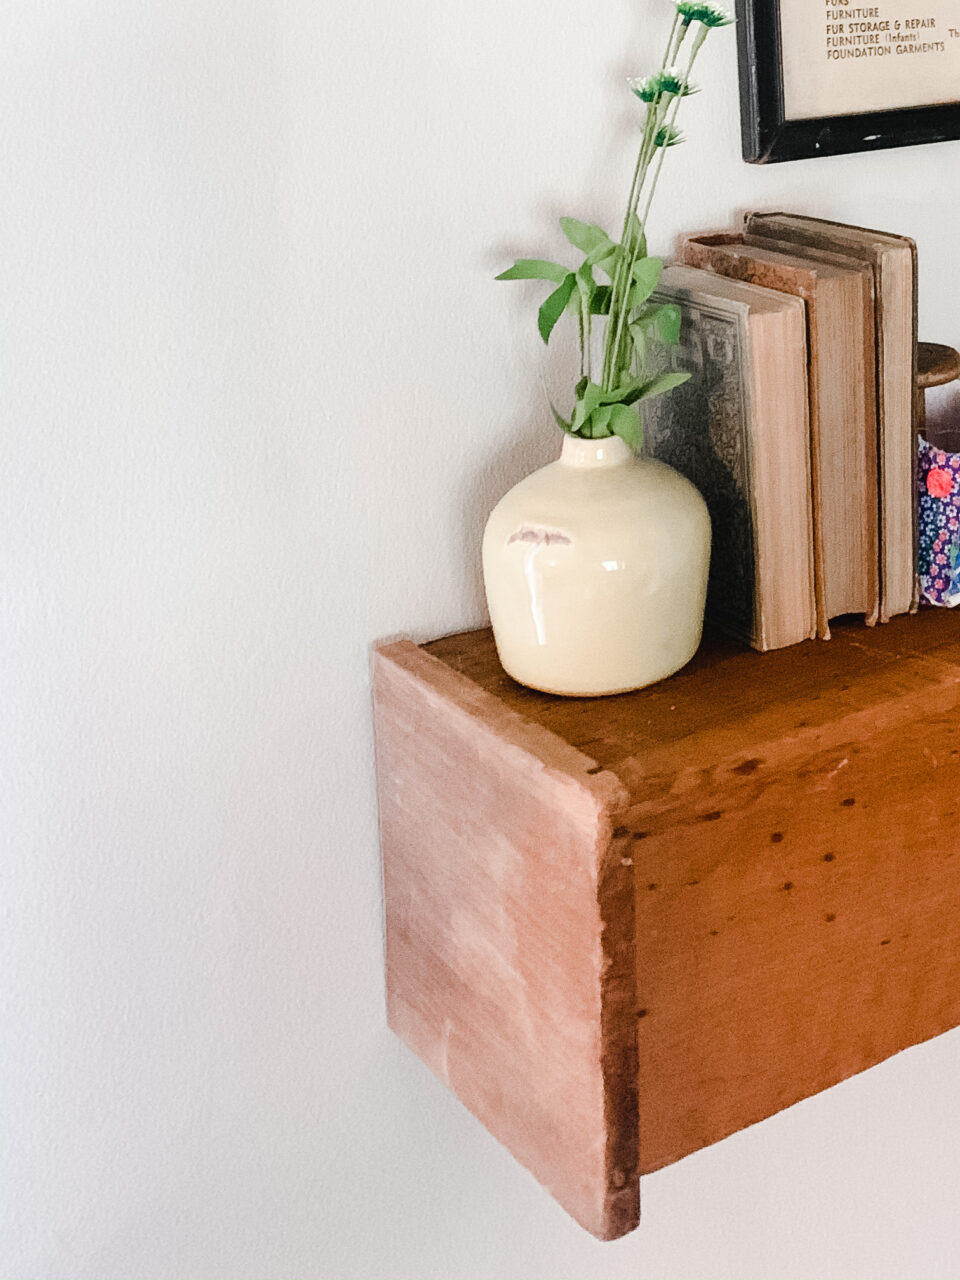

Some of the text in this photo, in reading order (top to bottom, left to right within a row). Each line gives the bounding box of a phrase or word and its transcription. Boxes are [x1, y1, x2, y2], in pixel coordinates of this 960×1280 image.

[826, 7, 878, 20] FURNITURE
[825, 17, 935, 34] FUR STORAGE & REPAIR
[827, 45, 891, 59] FOUNDATION
[895, 41, 944, 54] GARMENTS
